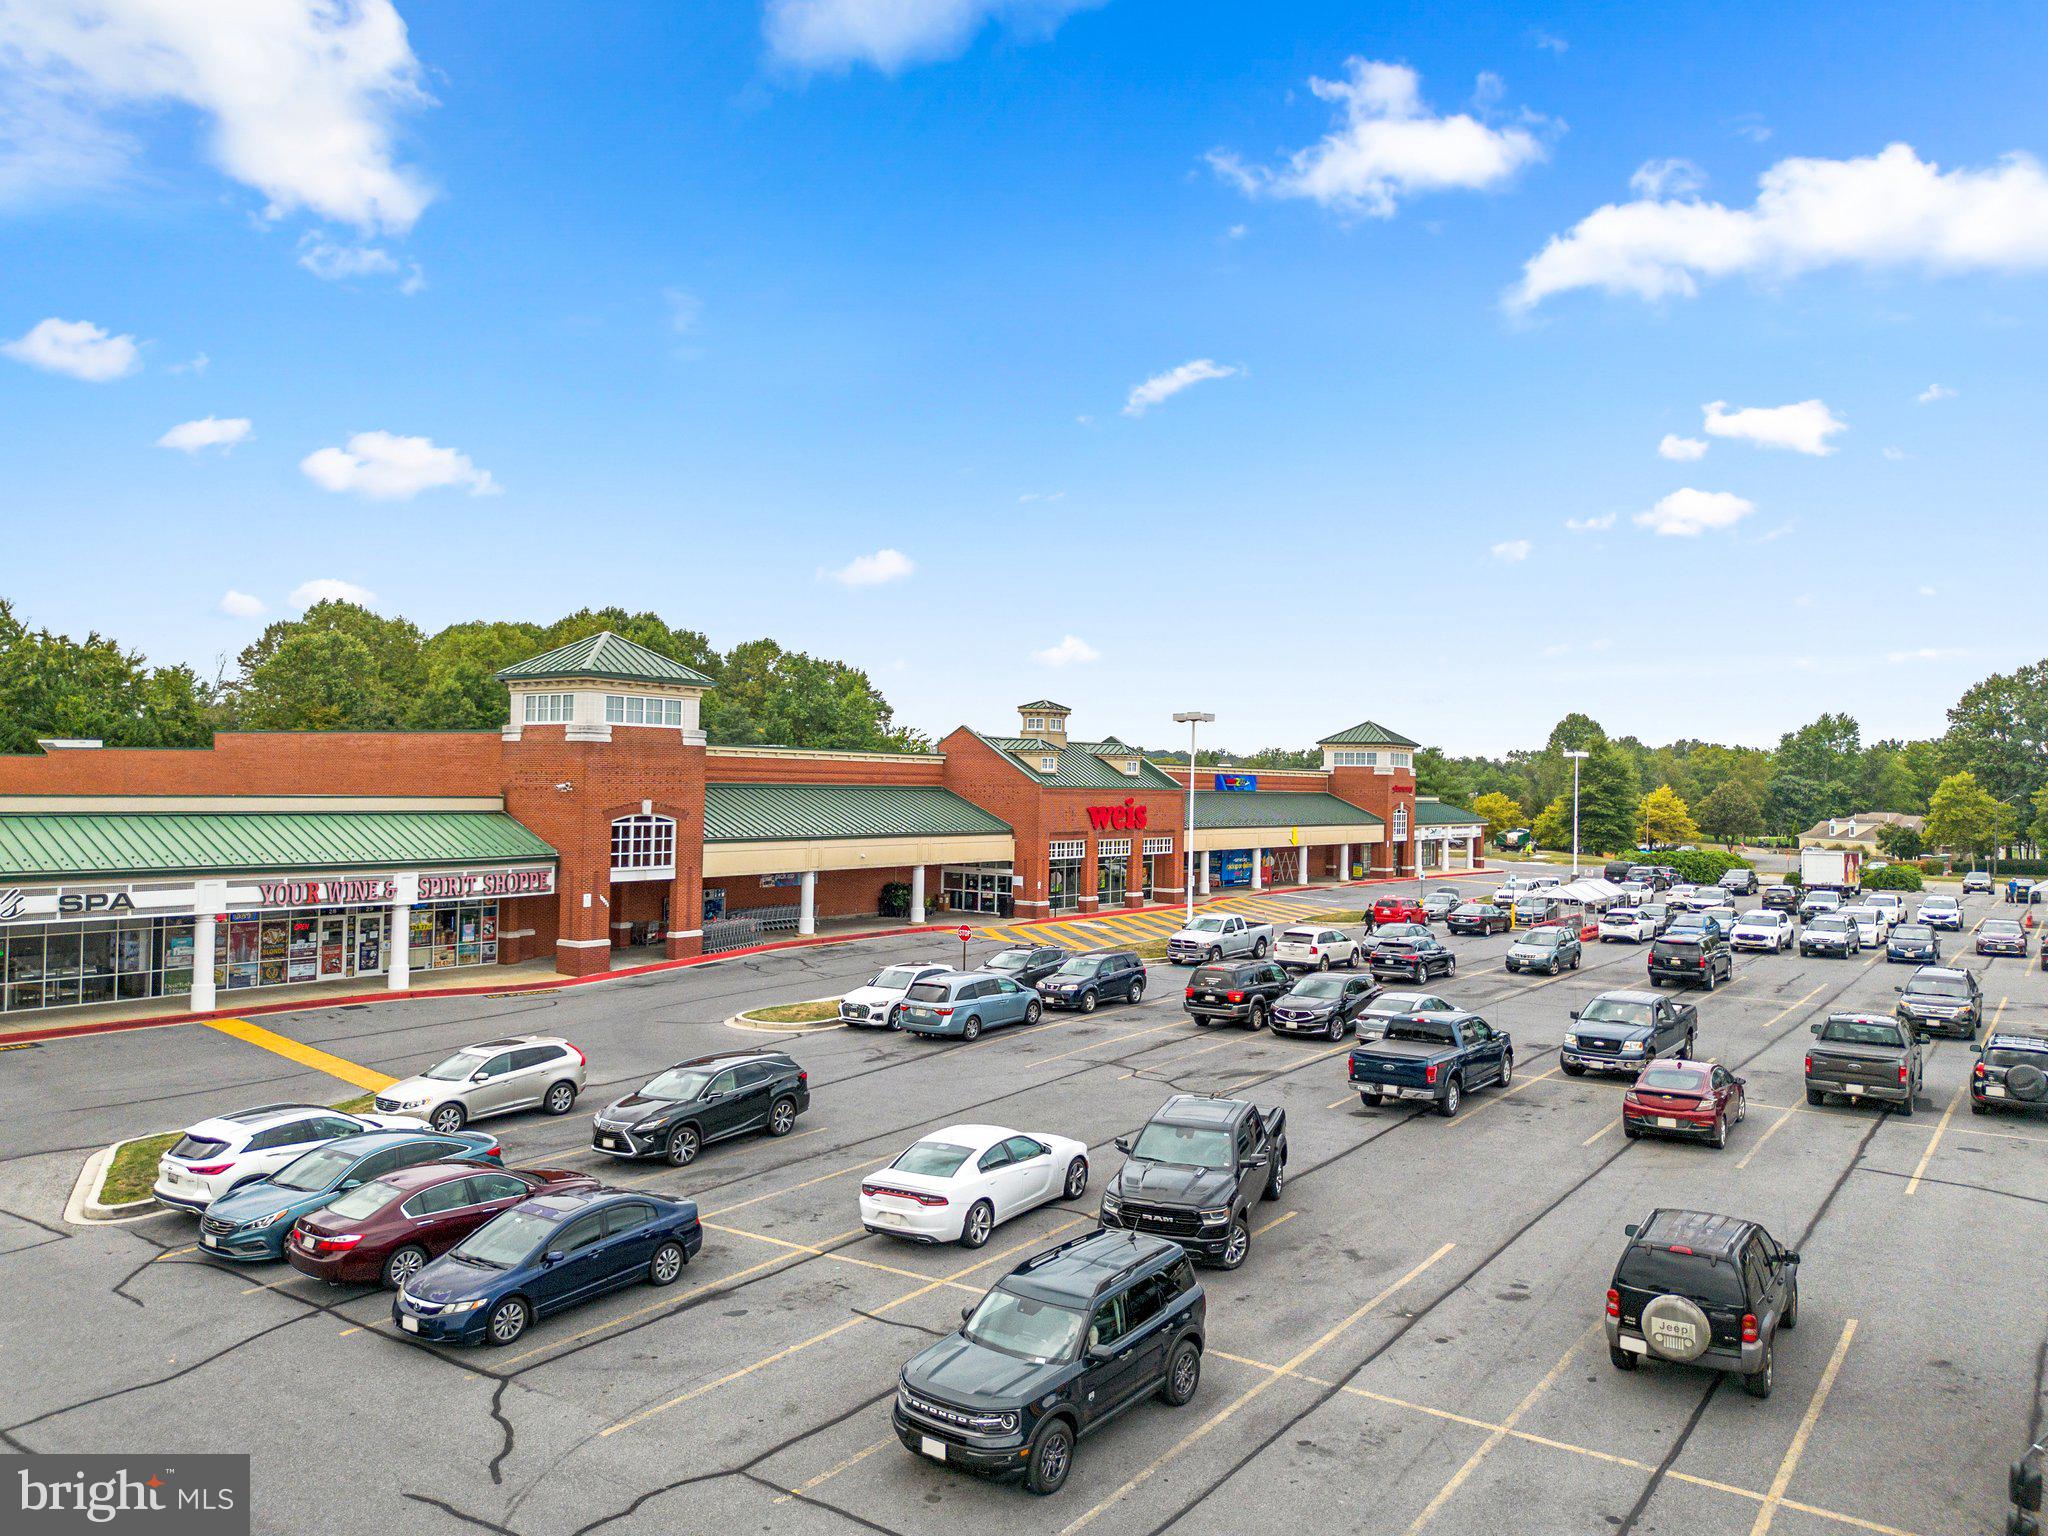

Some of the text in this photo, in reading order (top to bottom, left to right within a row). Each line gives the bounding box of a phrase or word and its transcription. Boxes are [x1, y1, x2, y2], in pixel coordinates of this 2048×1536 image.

[1087, 797, 1147, 830] weis
[261, 871, 552, 905] YOUR WINE & SPIRIT SHOPPE
[59, 892, 135, 912] SPA
[1142, 1214, 1173, 1222] RAM
[1659, 1321, 1688, 1336] Jeep
[912, 1400, 967, 1423] BRONCO
